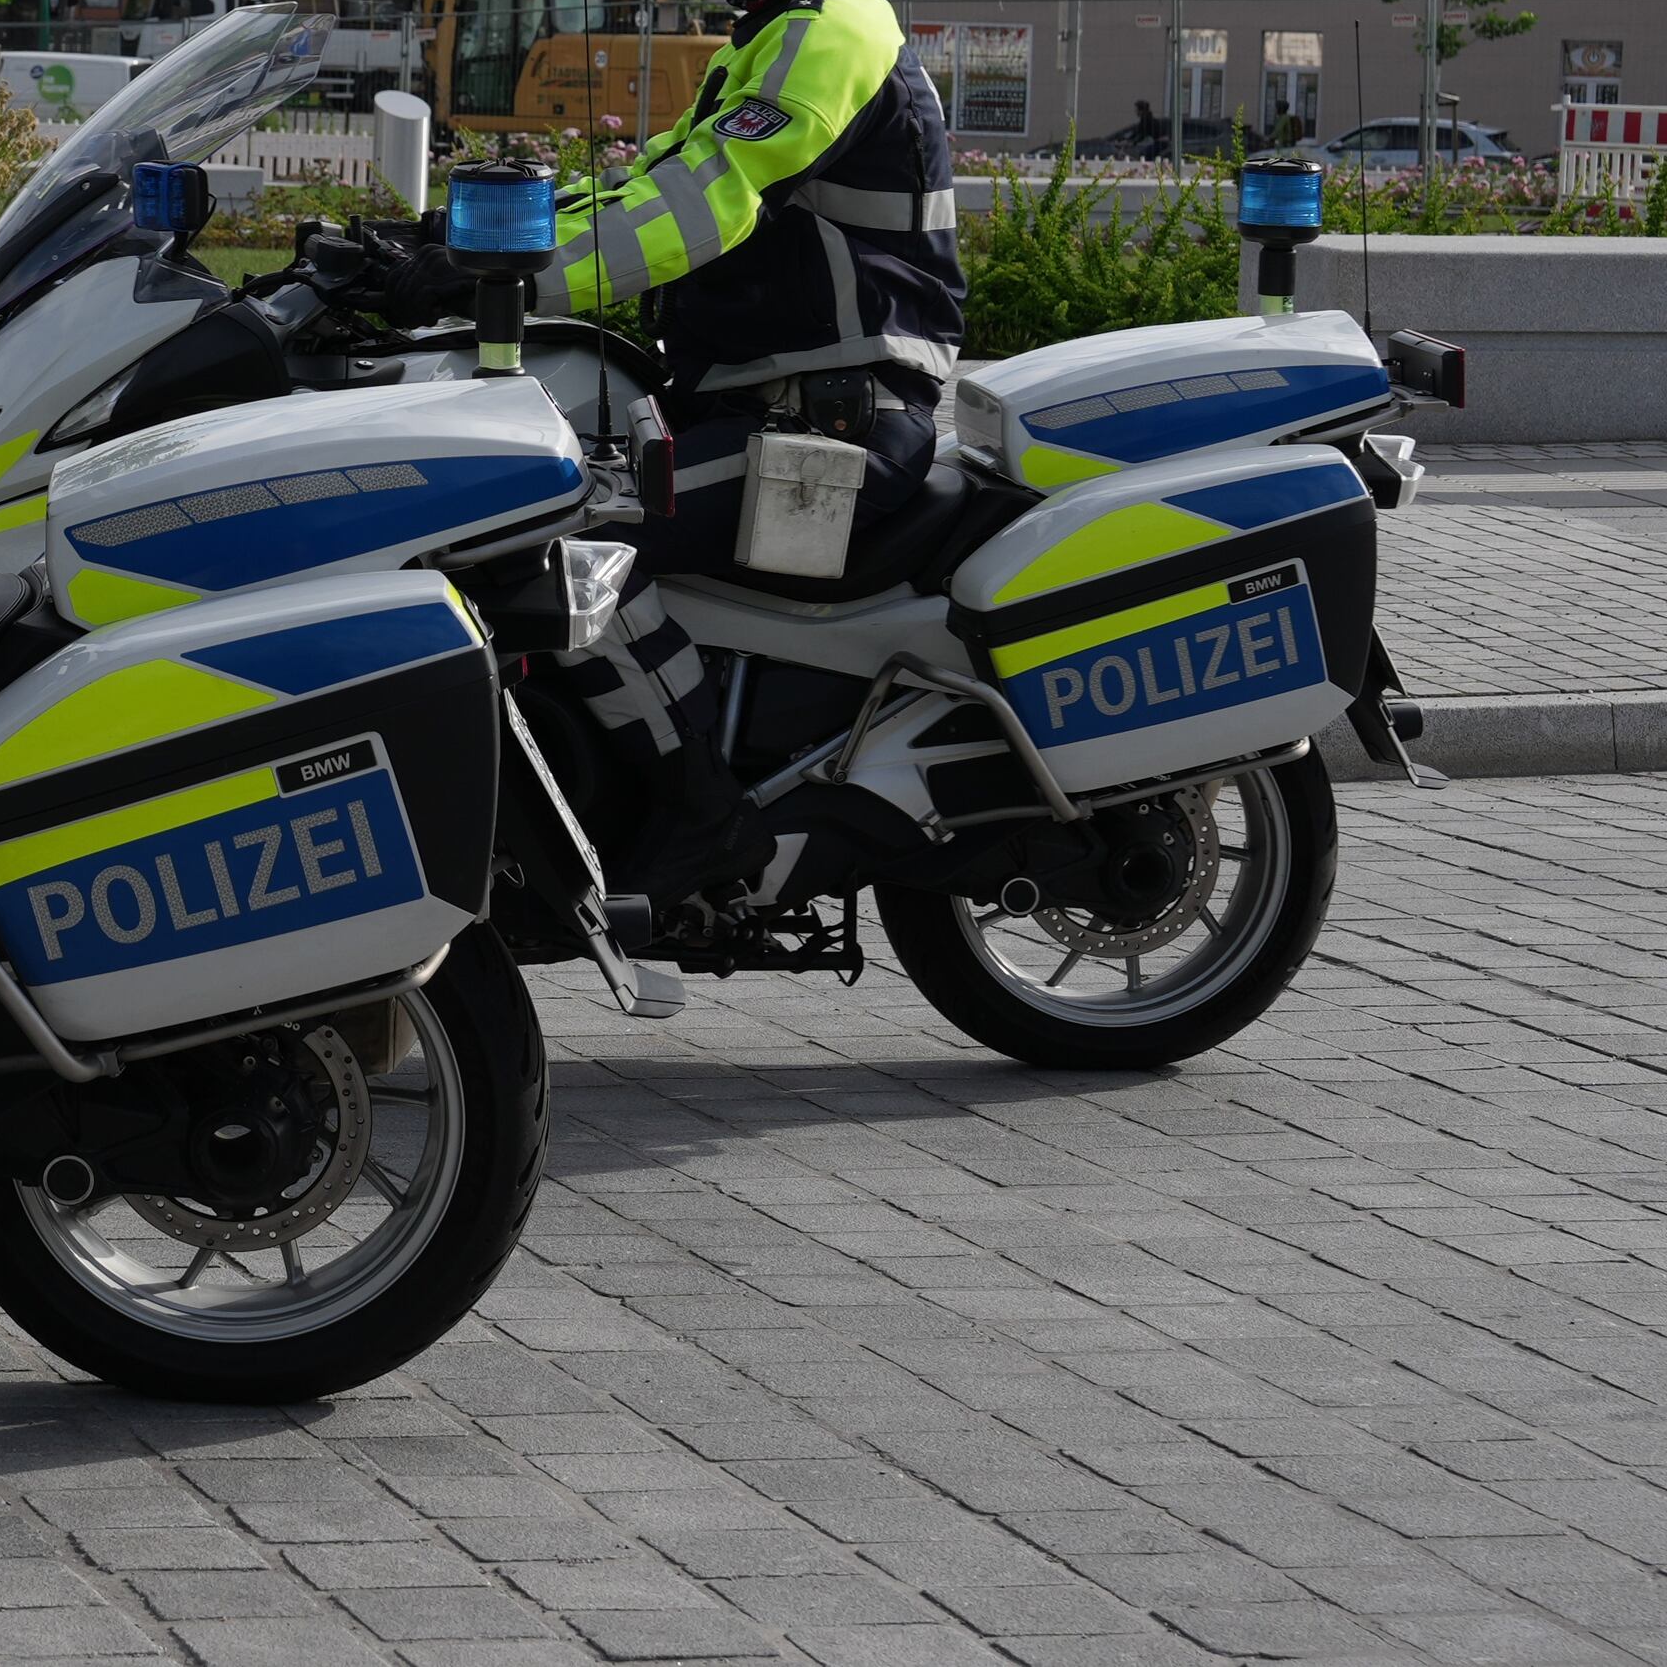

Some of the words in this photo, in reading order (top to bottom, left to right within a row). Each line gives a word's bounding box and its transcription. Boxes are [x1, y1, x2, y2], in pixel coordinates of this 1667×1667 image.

[746, 102, 783, 124] POLIZEI
[1245, 573, 1282, 595] BMW
[1042, 606, 1300, 729] POLIZEI
[300, 752, 351, 782] BMW
[27, 799, 383, 961] POLIZEI
